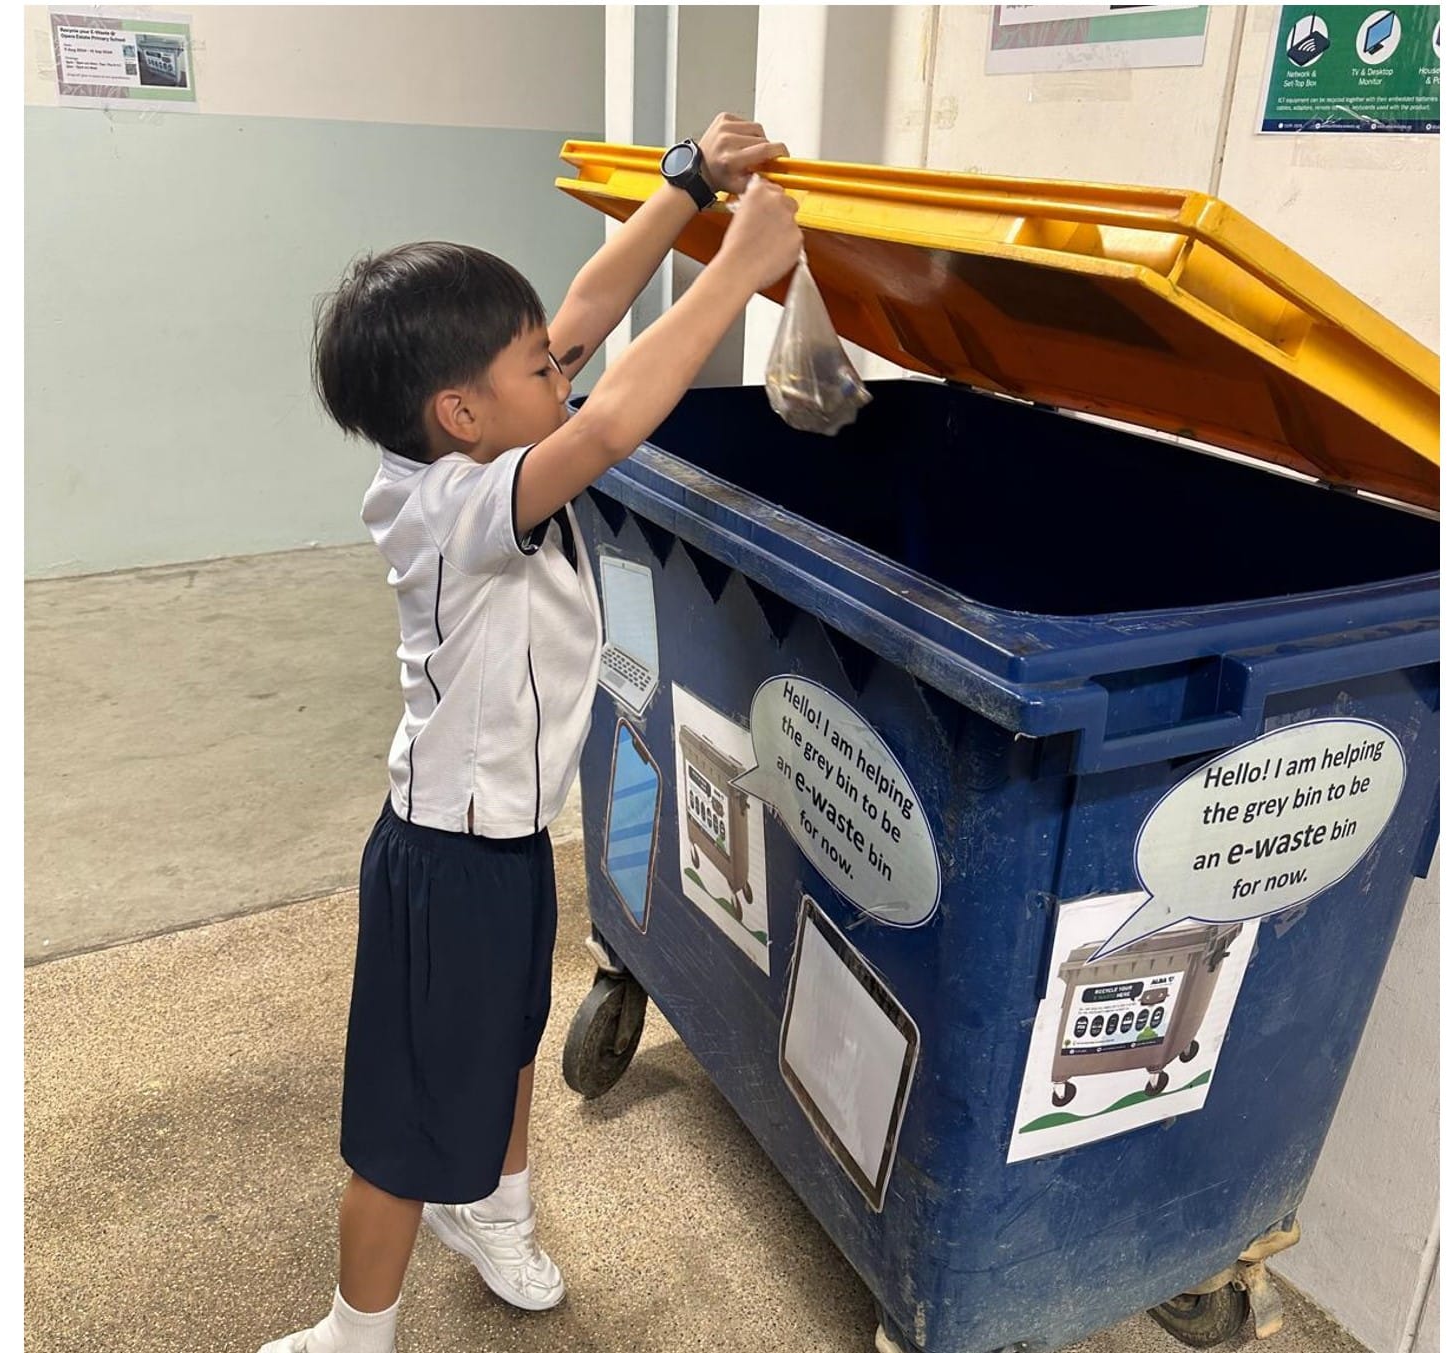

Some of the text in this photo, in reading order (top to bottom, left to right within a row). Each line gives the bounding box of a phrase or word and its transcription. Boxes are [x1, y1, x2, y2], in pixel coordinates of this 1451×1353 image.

[1287, 70, 1310, 78] Network
[1367, 68, 1394, 77] Desktop
[782, 681, 914, 820] Hello! I am helping
[1203, 740, 1385, 789] Hello! I am helping
[782, 715, 901, 843] the grey bin to be
[1203, 775, 1370, 825] the grey bin to be
[776, 755, 892, 882] an e-waste bin
[799, 809, 854, 880] for now.
[1192, 818, 1357, 871] an e-waste bin
[1231, 867, 1308, 900] for now.
